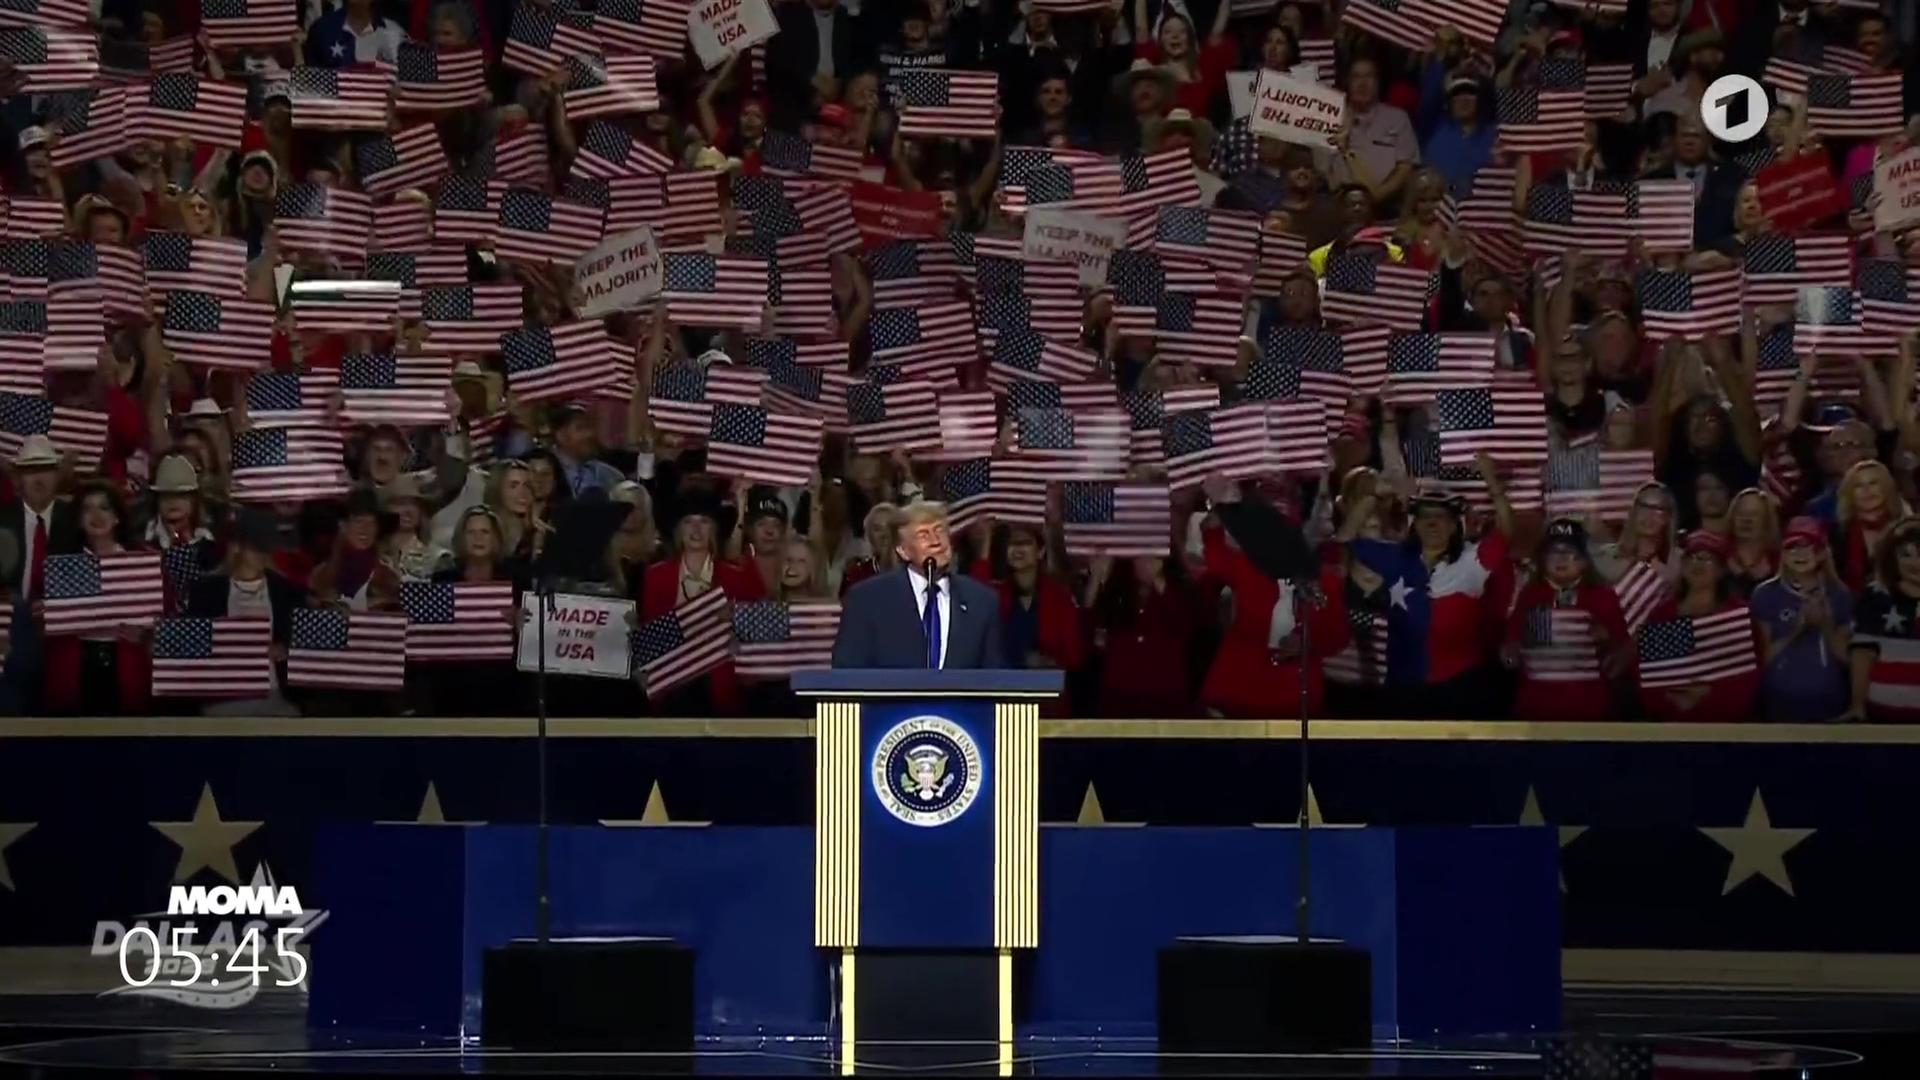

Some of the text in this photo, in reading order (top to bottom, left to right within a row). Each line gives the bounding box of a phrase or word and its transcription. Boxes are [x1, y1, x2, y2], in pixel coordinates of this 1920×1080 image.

[718, 23, 747, 46] USA
[1262, 87, 1340, 118] MAJORITY
[1262, 106, 1290, 125] THE
[579, 241, 649, 281] KEEP THE
[584, 260, 658, 300] MAJORITY
[548, 608, 610, 626] MADE
[558, 628, 597, 640] IN THE
[555, 643, 595, 662] USA
[876, 719, 926, 769] PRESIDENT
[956, 735, 979, 782] UNITED
[890, 800, 917, 821] SEAL
[936, 787, 975, 821] STATES
